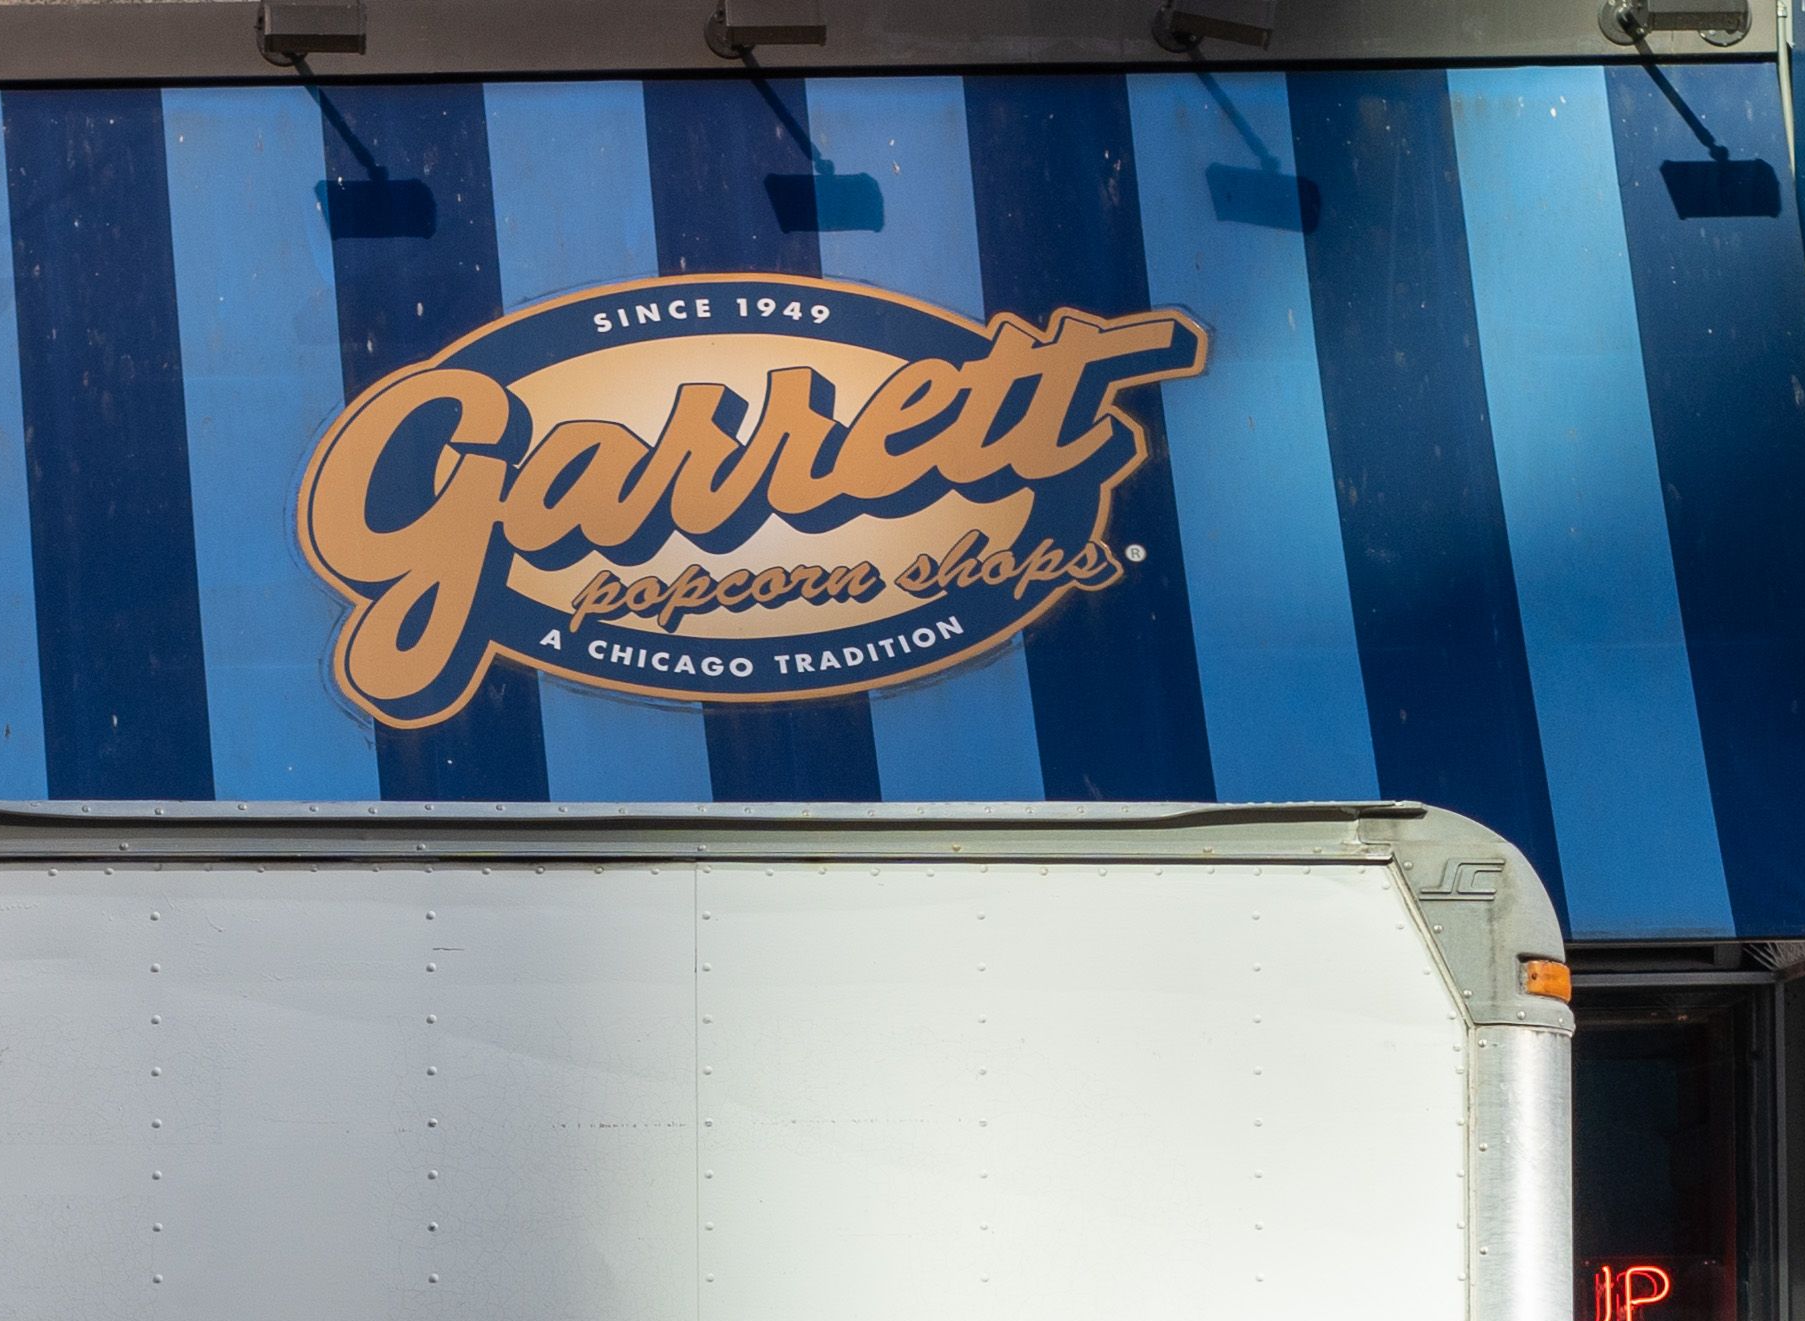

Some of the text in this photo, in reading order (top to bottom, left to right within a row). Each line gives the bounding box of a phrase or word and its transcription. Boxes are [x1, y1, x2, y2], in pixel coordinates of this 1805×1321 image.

[592, 296, 833, 334] SINCE 1949
[307, 318, 1178, 702] Garrett
[568, 528, 1110, 633] popcorn shops
[539, 614, 966, 679] A CHICAGO TRADITION
